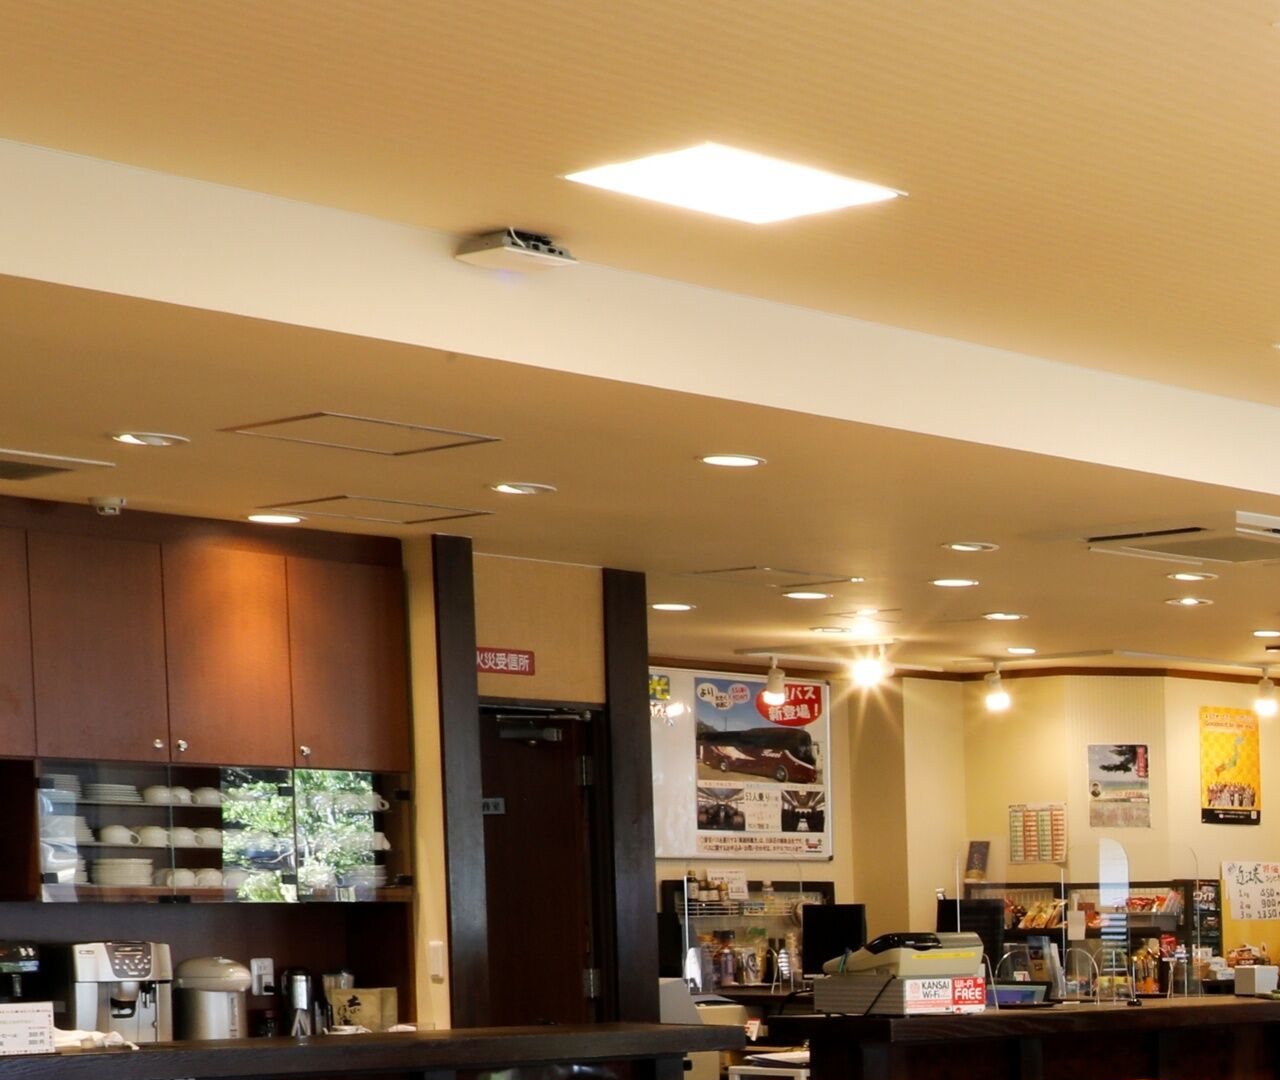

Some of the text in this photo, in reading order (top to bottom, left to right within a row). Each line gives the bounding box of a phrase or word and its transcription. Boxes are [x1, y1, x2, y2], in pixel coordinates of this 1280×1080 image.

[922, 981, 949, 990] KANSAI
[922, 991, 940, 999] Wi-Fi
[955, 988, 982, 1000] FREE
